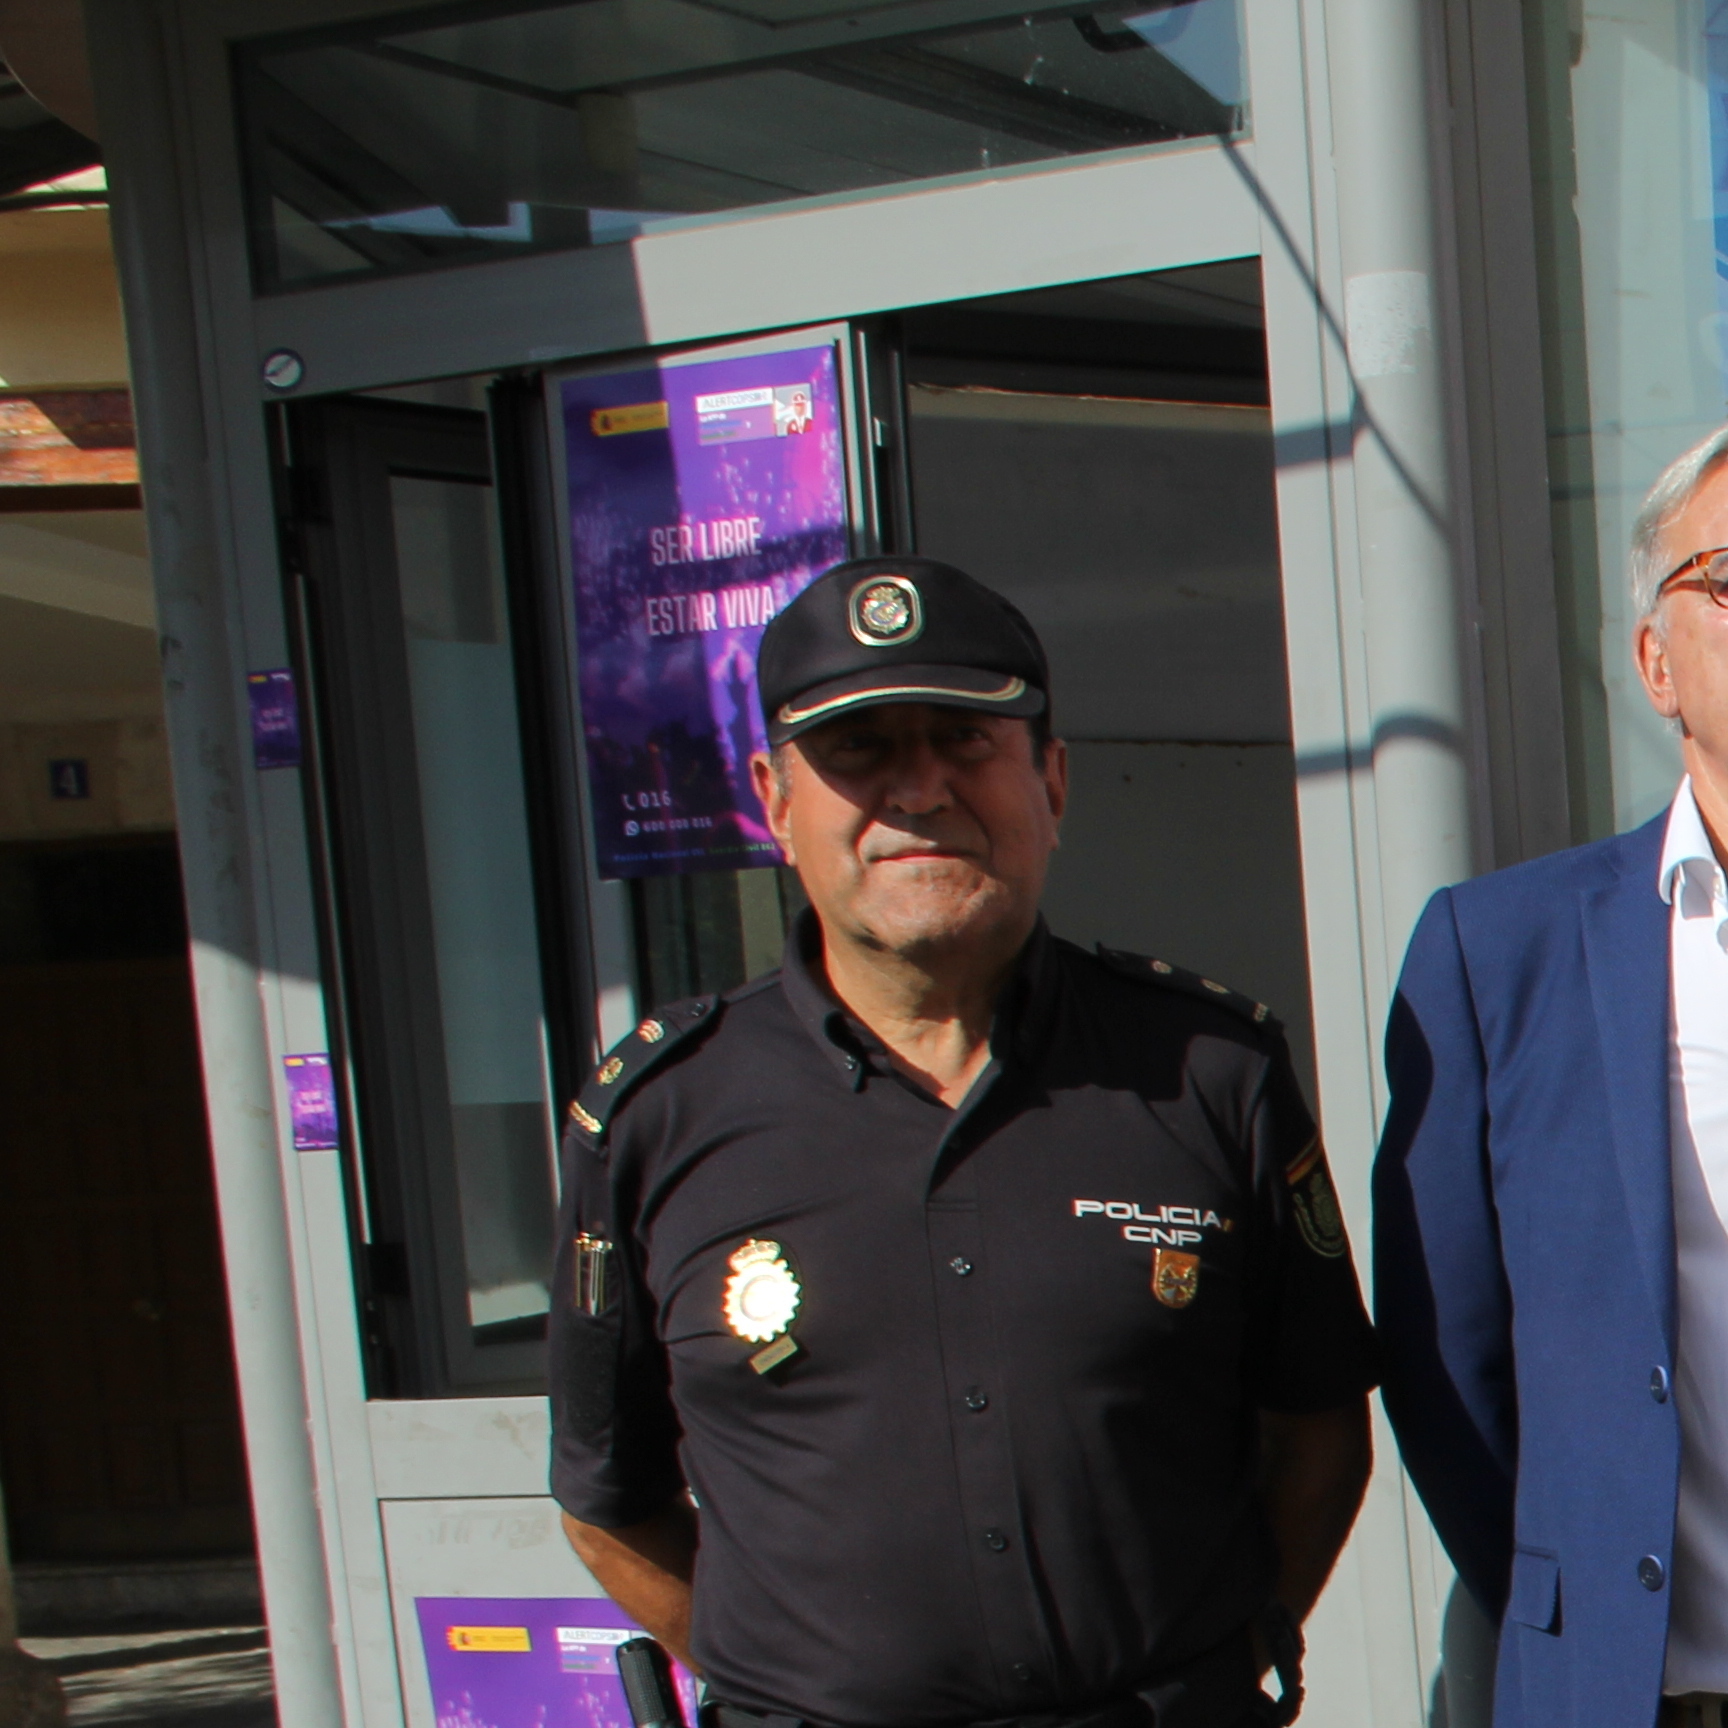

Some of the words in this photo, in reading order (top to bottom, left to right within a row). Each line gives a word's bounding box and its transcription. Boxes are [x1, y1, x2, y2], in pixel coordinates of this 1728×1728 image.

[650, 522, 693, 566] SER
[698, 516, 763, 562] LIBRE
[646, 594, 717, 636] ESTAR
[720, 585, 776, 630] VIVA
[638, 790, 672, 809] 016
[1074, 1199, 1223, 1229] POLICIA
[1123, 1225, 1202, 1247] CNP
